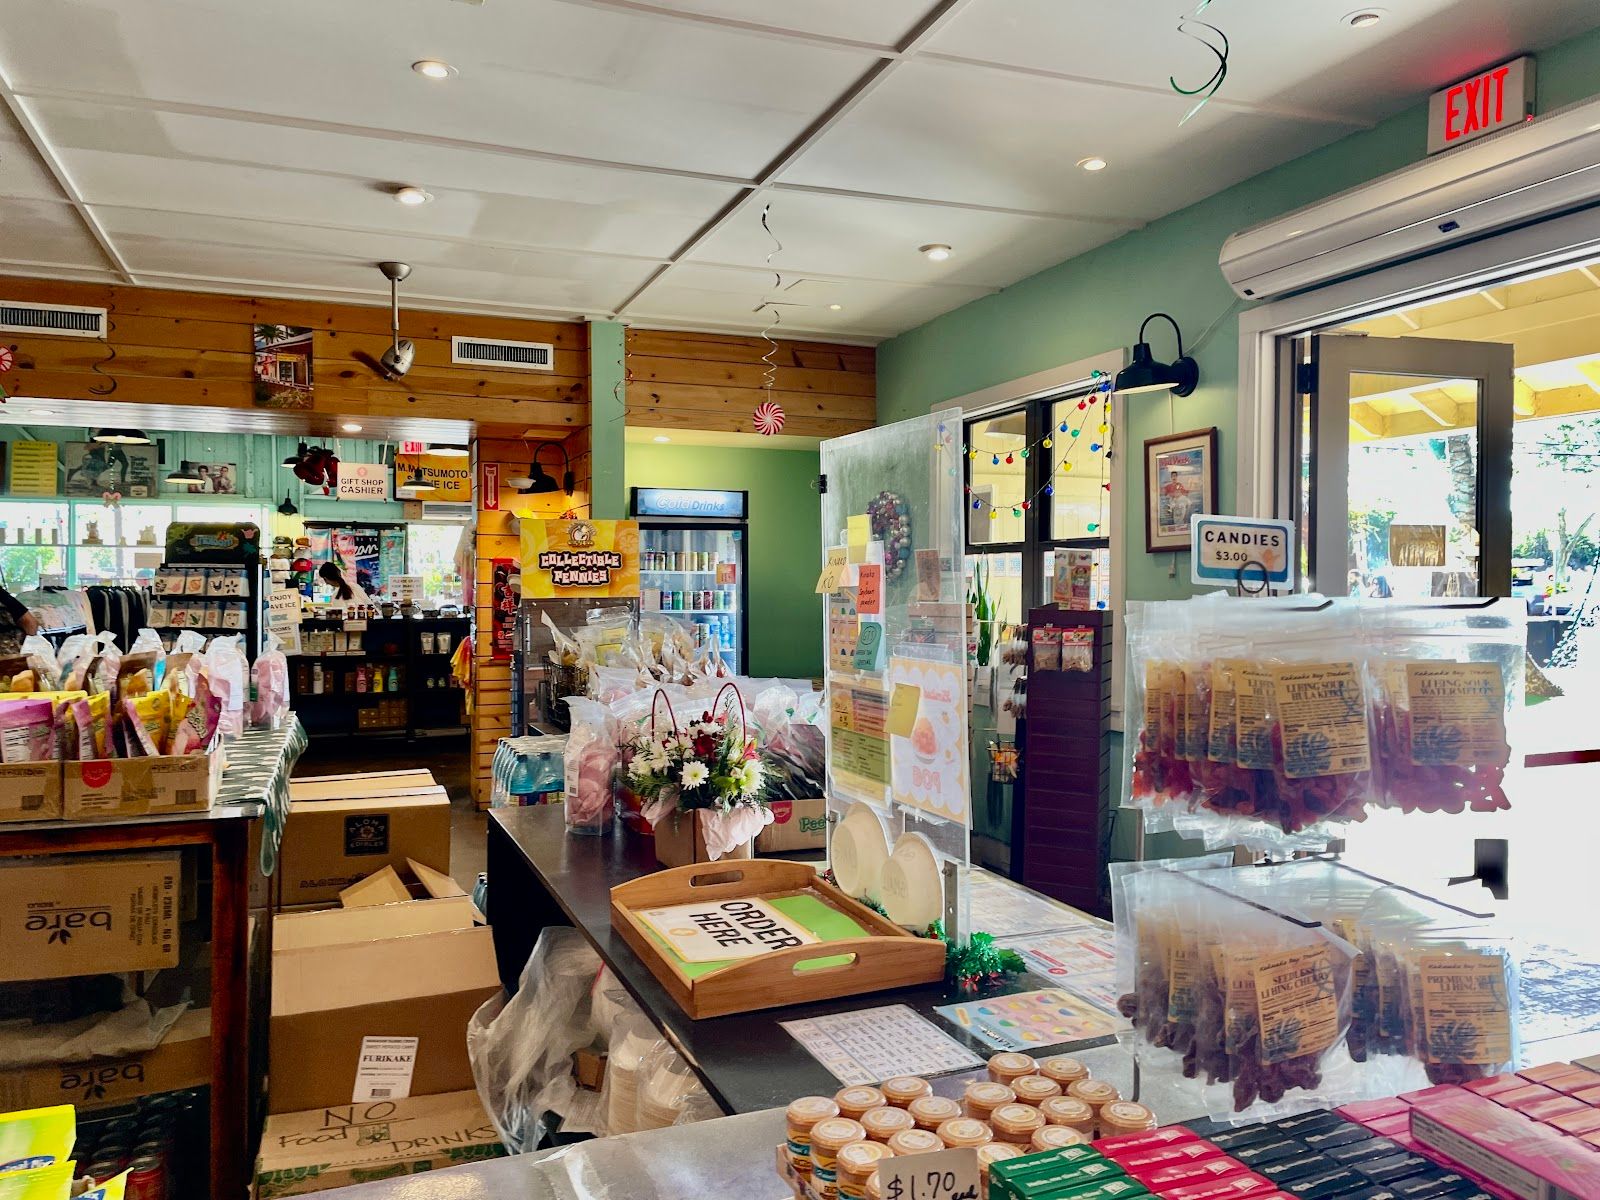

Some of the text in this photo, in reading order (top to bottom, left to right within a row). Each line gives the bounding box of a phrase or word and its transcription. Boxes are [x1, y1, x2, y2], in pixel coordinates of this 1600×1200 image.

[1444, 66, 1509, 142] EXIT
[341, 486, 384, 495] CASHIER
[443, 481, 461, 490] ICE
[692, 500, 725, 511] Drinks
[1204, 529, 1280, 548] CANDIES
[540, 552, 620, 567] COLLECTIBLE
[1215, 549, 1249, 562] $3.00
[553, 570, 608, 583] PENNIES
[269, 594, 292, 602] ENJOY
[799, 815, 827, 833] Pee
[25, 911, 112, 931] bare
[719, 900, 803, 951] ORDER
[688, 912, 753, 950] HERE
[1426, 975, 1474, 984] PREMIUM
[362, 1054, 413, 1063] FURIKAKE
[59, 1064, 145, 1091] bare
[324, 1101, 397, 1127] NO
[279, 1126, 349, 1148] Food
[391, 1125, 498, 1153] DRINKS
[886, 1171, 956, 1200] $1.70
